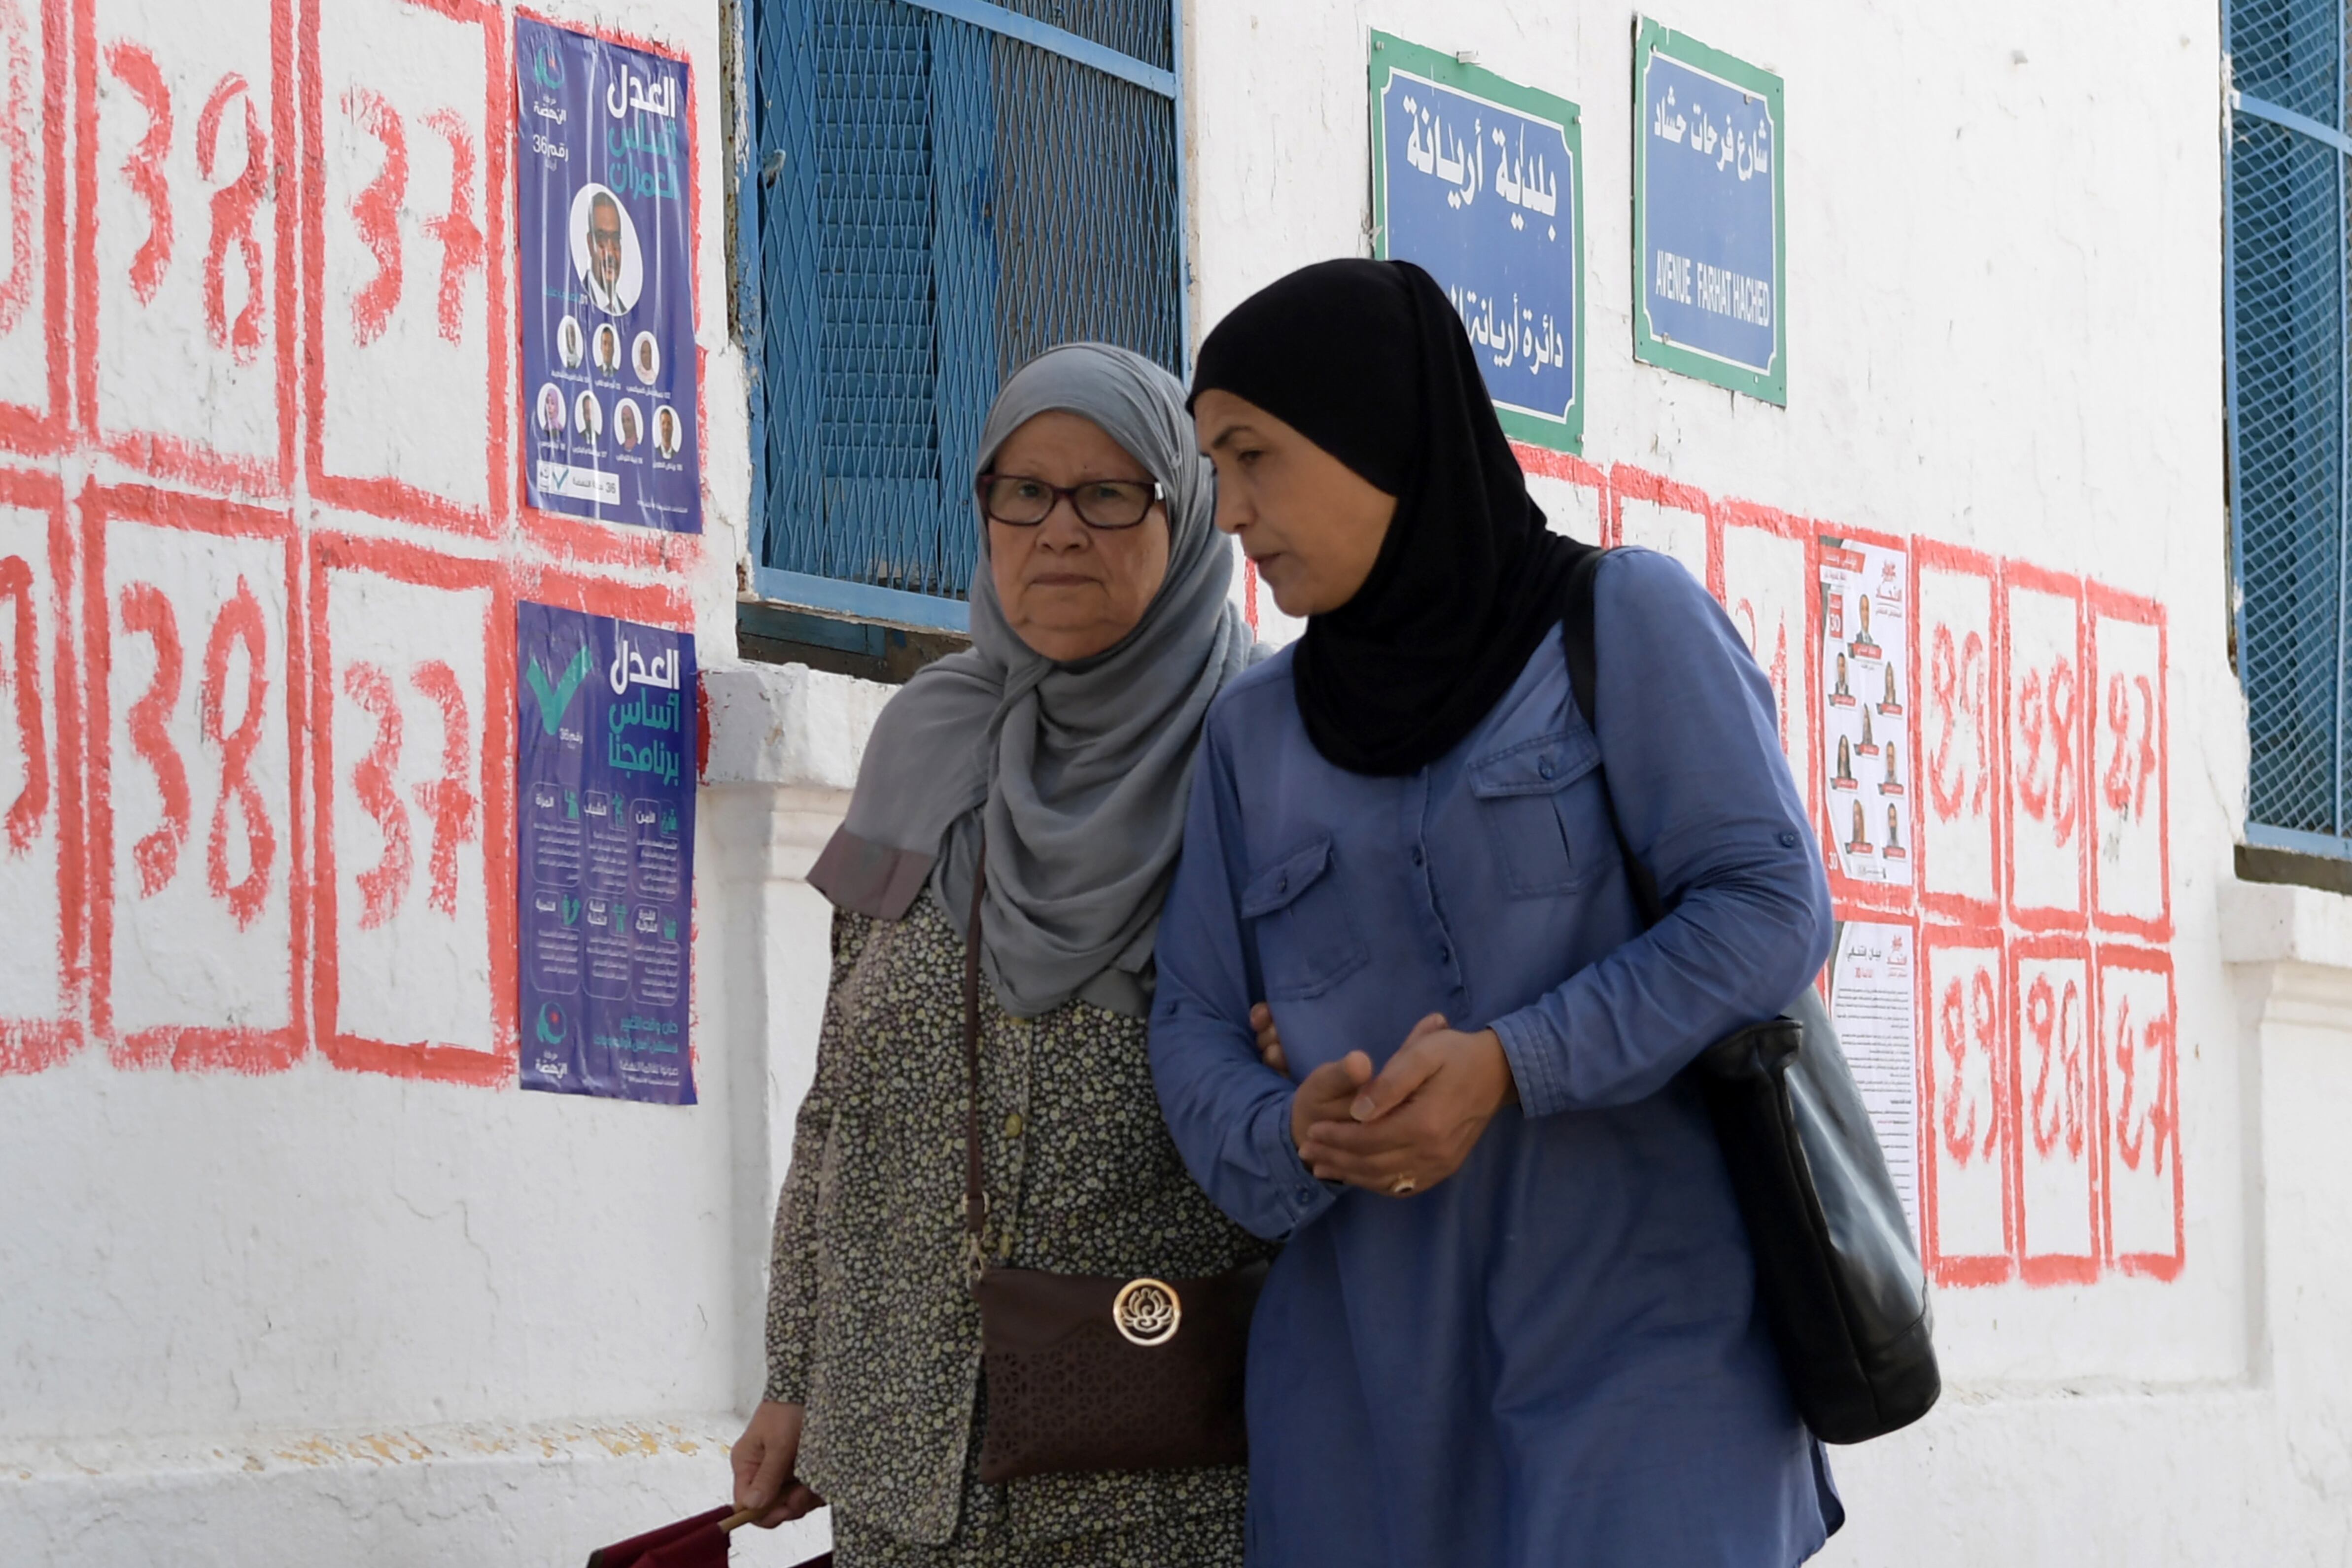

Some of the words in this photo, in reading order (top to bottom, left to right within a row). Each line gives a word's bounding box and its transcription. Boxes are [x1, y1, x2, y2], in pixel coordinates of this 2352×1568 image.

[607, 64, 675, 118] العدل
[1655, 85, 1687, 143] حشاد
[1403, 95, 1483, 210] أريانة
[1691, 103, 1734, 172] فرحات
[1737, 118, 1767, 181] شارع
[102, 37, 268, 367] 38
[341, 76, 486, 349] 37
[1656, 249, 1692, 305] AVENUE
[1697, 262, 1731, 316] FARHAT
[1732, 273, 1769, 327] HACHED
[1522, 308, 1563, 375] دائرة
[610, 640, 680, 695] العدل
[609, 687, 680, 733] أساس
[120, 573, 276, 932] 38
[608, 732, 679, 786] برنامجنا
[344, 659, 481, 930] 37
